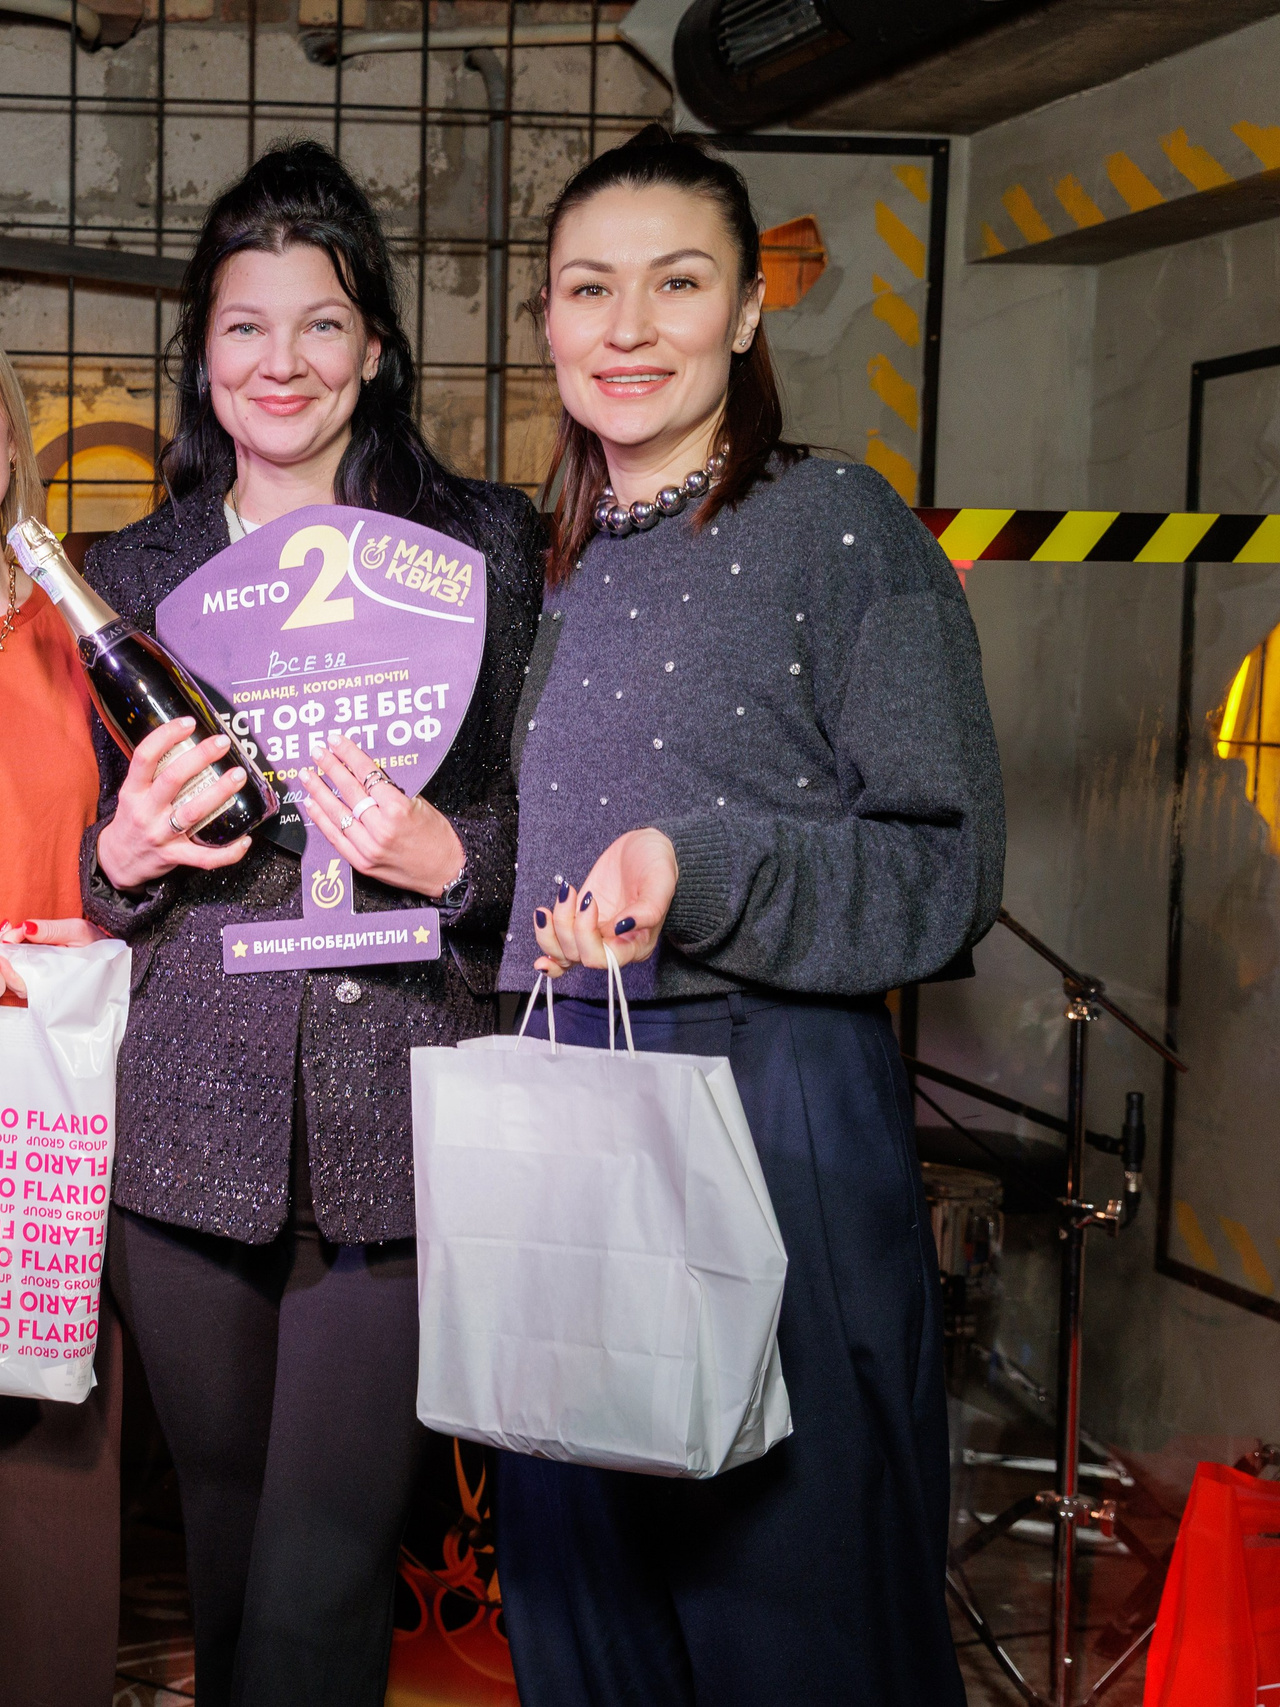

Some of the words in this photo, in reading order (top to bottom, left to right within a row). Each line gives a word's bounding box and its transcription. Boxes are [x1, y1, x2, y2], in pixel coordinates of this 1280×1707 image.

[394, 539, 473, 587] МАМА
[202, 580, 290, 615] МЕСТО
[279, 524, 355, 631] 2
[385, 559, 470, 607] КВИЗ!
[232, 684, 299, 705] КОМАНДЕ,
[303, 675, 362, 694] КОТОРАЯ
[365, 669, 410, 686] ПОЧТИ
[272, 699, 326, 731] ОФ
[333, 694, 369, 723] ЗЕ
[377, 683, 450, 718] БЕСТ
[266, 733, 301, 762] ЗЕ
[386, 714, 442, 747] ОФ
[389, 753, 419, 768] БЕСТ
[276, 767, 298, 781] ОФ
[279, 813, 301, 825] ДАТА
[253, 929, 409, 955] ВИЦЕ-ПОБЕДИТЕЛИ
[27, 1110, 108, 1135] FLARIO
[26, 1136, 65, 1149] GROUP
[69, 1140, 108, 1151] GROUP
[25, 1152, 108, 1177] FLARIO
[23, 1180, 106, 1205] FLARIO
[23, 1206, 62, 1219] GROUP
[66, 1209, 105, 1221] GROUP
[21, 1249, 101, 1274] FLARIO
[21, 1276, 60, 1289] GROUP
[18, 1319, 98, 1343] FLARIO
[18, 1346, 59, 1358] GROUP
